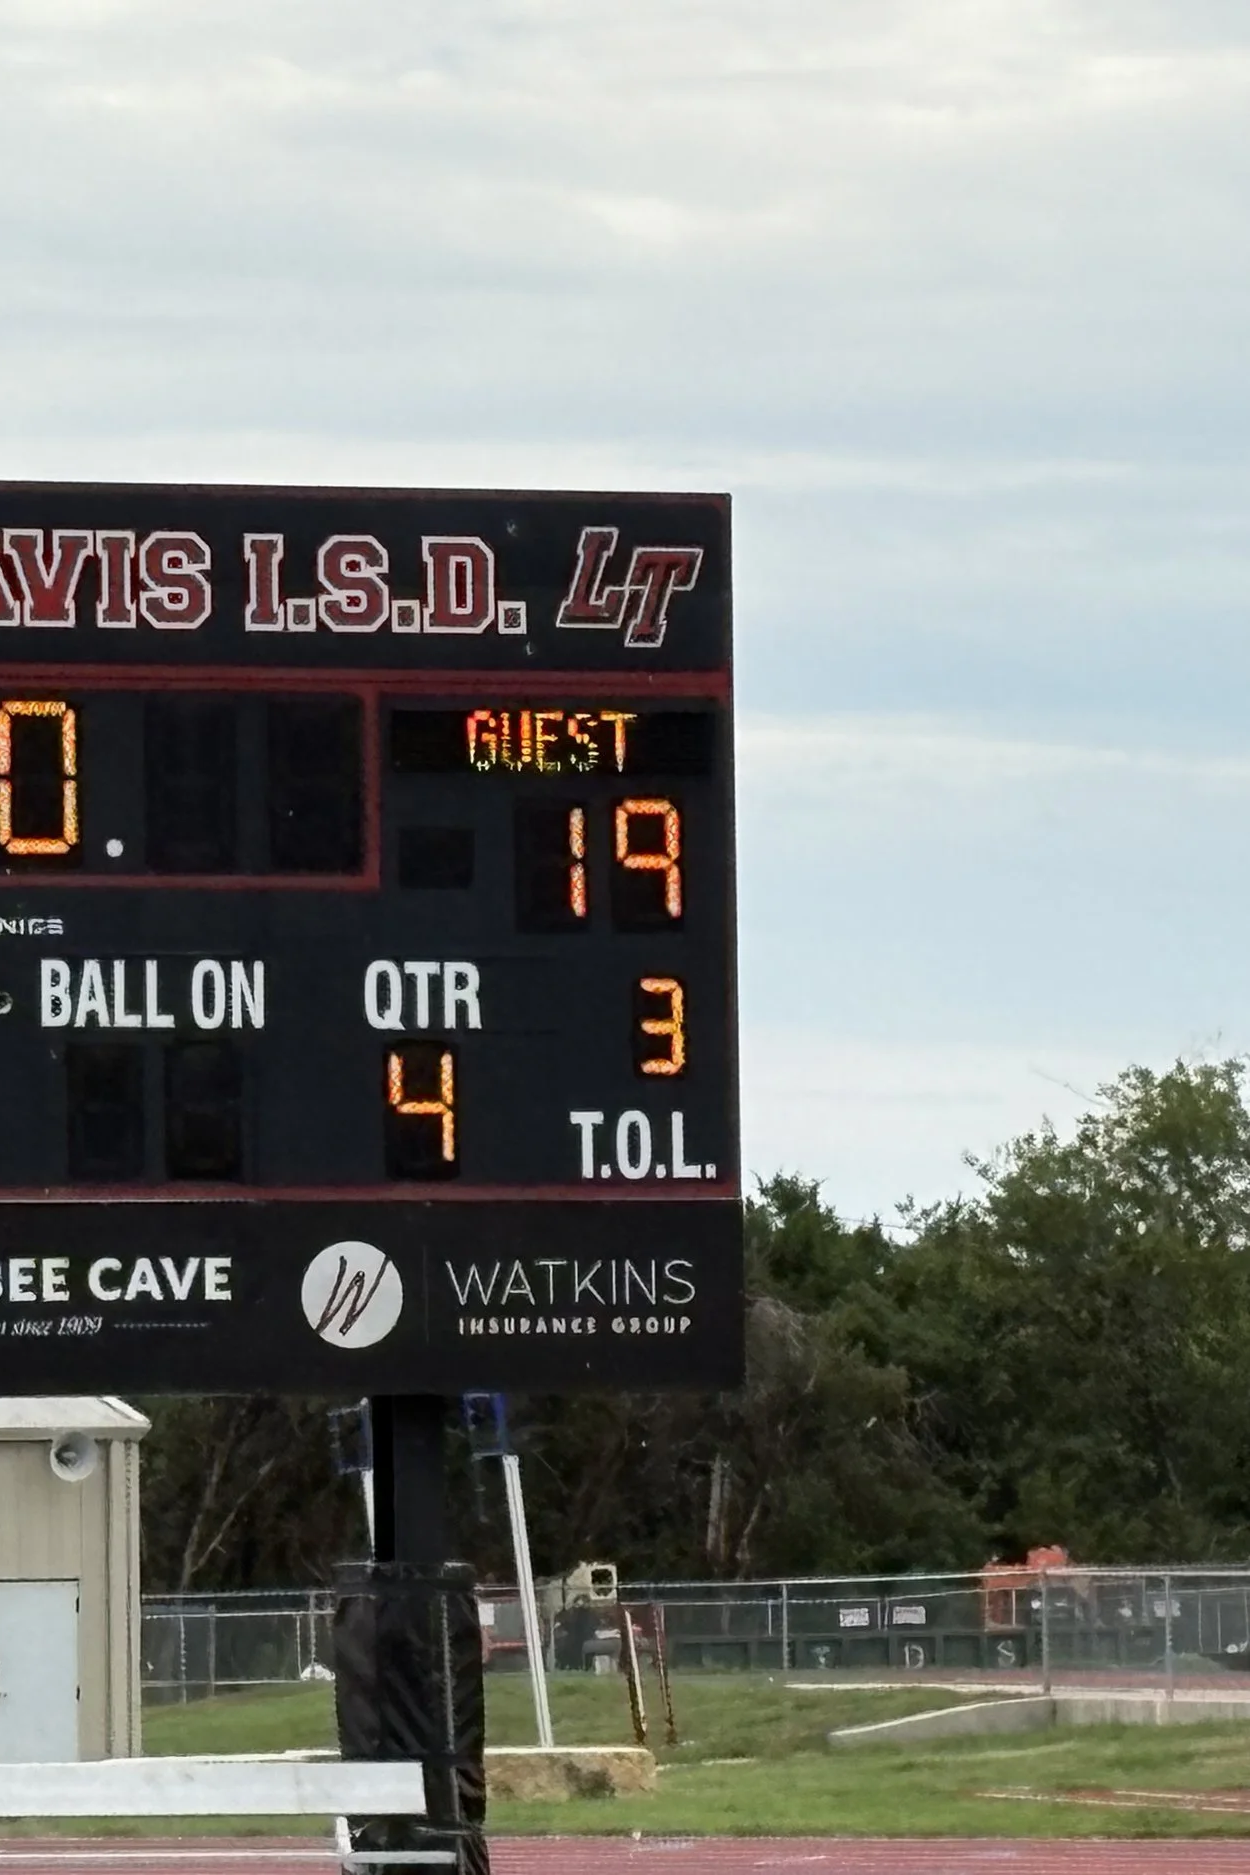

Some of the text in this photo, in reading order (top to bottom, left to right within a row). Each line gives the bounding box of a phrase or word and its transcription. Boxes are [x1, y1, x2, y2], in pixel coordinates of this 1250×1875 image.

[244, 533, 527, 634] I.S.D.
[556, 527, 703, 647] LT
[466, 710, 637, 772] GUEST
[570, 799, 681, 917] 19
[41, 959, 264, 1029] BALL ON
[365, 960, 482, 1030] QTR
[641, 978, 685, 1075] 3
[388, 1053, 454, 1161] 4
[570, 1110, 716, 1179] T.O.L.
[88, 1257, 231, 1301] CAVE
[446, 1260, 695, 1305] WATKINS
[455, 1316, 692, 1337] INSURANCE GROUP
